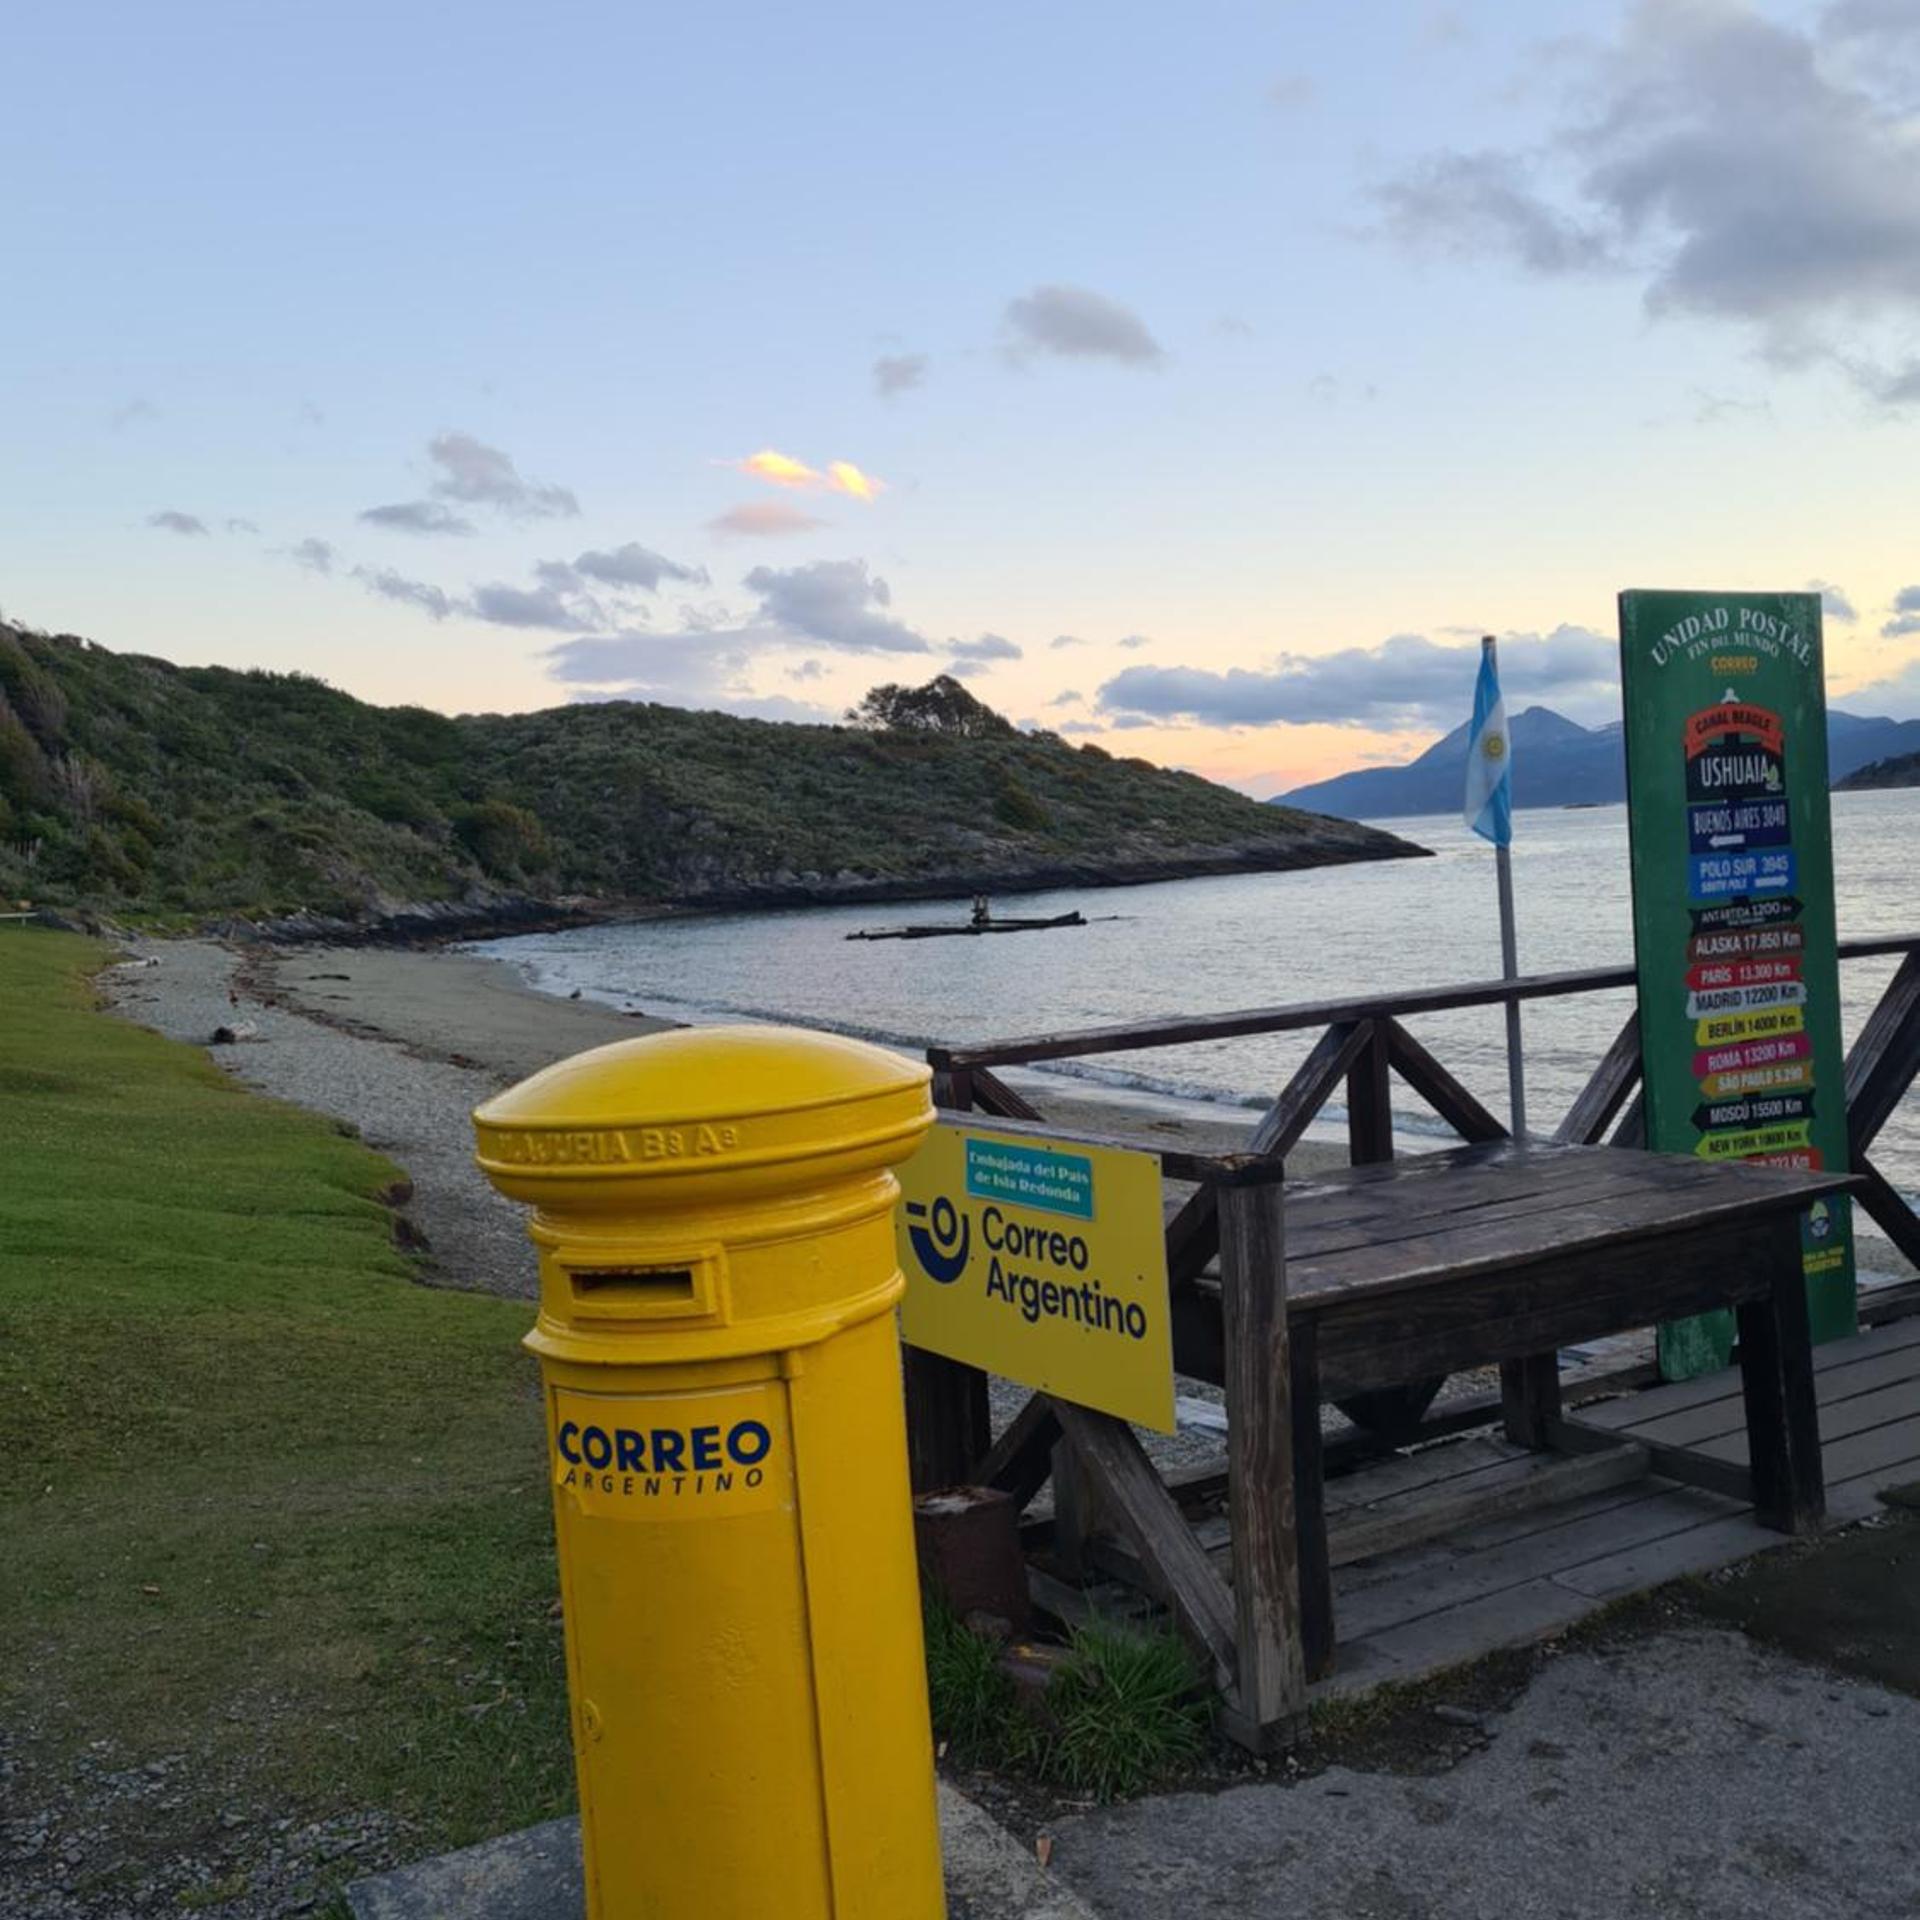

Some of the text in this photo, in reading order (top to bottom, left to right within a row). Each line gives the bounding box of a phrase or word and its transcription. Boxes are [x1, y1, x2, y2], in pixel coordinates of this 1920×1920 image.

[1651, 607, 1811, 667] UNIDAD POSTAL
[1687, 638, 1711, 660] FIN
[1733, 631, 1780, 658] MUNDO
[1711, 655, 1758, 670] CORREO
[1700, 754, 1769, 787] USHUAIA
[1693, 808, 1733, 835] BUENOS
[1734, 806, 1761, 831] AIRES
[1701, 860, 1731, 878] POLO
[1733, 858, 1757, 876] SUR
[1695, 936, 1742, 955] ALASKA
[1782, 931, 1801, 947] Km
[1775, 963, 1791, 977] Km
[1696, 990, 1742, 1011] MADRID
[1780, 985, 1799, 998] Km
[1780, 1014, 1797, 1028] Km
[1708, 1053, 1743, 1072] ROMA
[1778, 1042, 1796, 1057] Km
[1785, 1099, 1803, 1114] Km
[1709, 1138, 1731, 1153] NEW
[1786, 1129, 1802, 1143] Km
[968, 1151, 1031, 1174] Embajada
[1033, 1162, 1056, 1178] del
[974, 1170, 1081, 1203] de Isla Redonda
[981, 1206, 1089, 1271] Correo
[986, 1256, 1147, 1340] Argentino
[557, 1418, 773, 1474] CORREO
[564, 1467, 764, 1496] ARGENTINO
